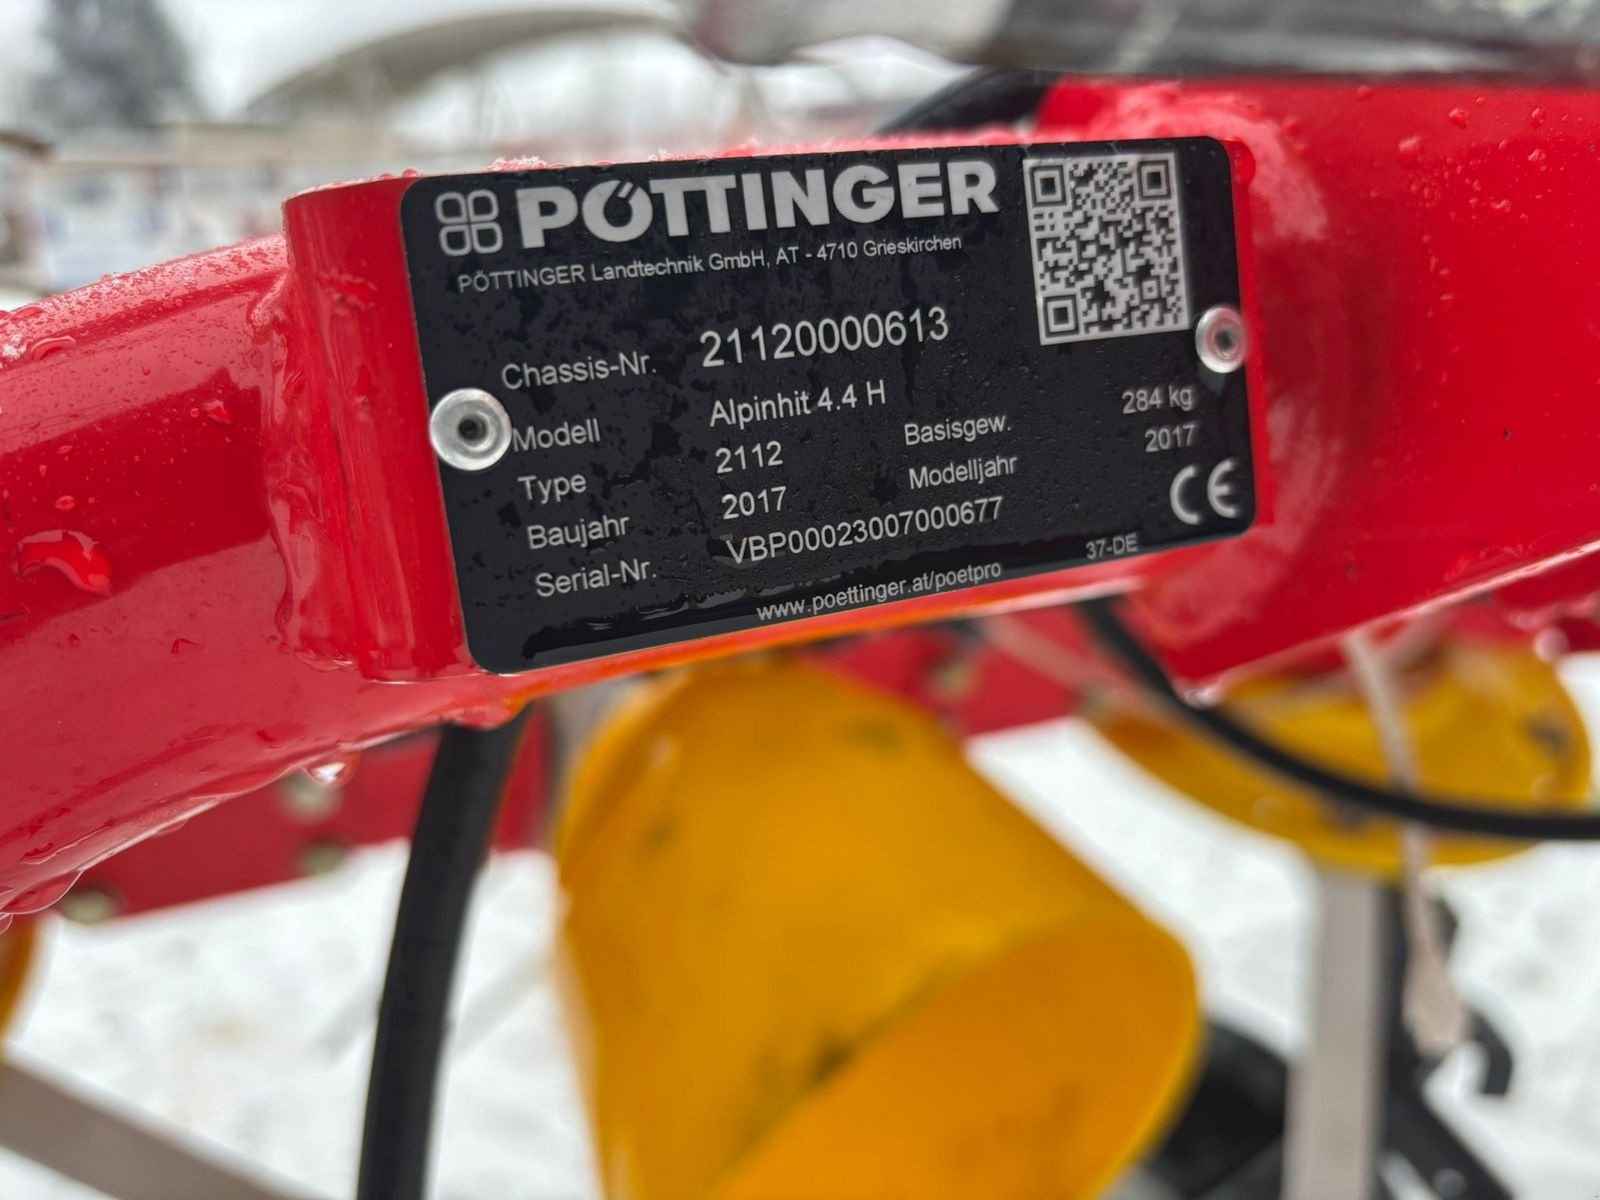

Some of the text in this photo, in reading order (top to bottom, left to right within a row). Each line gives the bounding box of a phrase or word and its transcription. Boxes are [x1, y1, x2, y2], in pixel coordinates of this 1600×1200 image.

[515, 159, 1000, 249] PÖTTINGER
[458, 263, 585, 294] PÖTTINGER
[591, 256, 703, 281] Landtechnik
[708, 247, 771, 270] GmbH,
[776, 246, 799, 266] AT
[816, 241, 858, 261] 4710
[863, 234, 962, 258] Grieskirchen
[501, 306, 949, 391] Chassis-Nr. 21120000613
[512, 379, 1194, 451] Modell Alpinhit 4.4 H 284 kg
[517, 413, 1197, 504] Type 2112 Basisgew. 2017
[1169, 457, 1241, 526] CE
[527, 453, 1018, 549] Baujahr 2017 Modelljahr
[534, 496, 1004, 597] Serial-Nr. VBP00023007000677
[1086, 533, 1140, 561] 37-DE
[756, 561, 1003, 622] www.poettinger.at/poetpro
